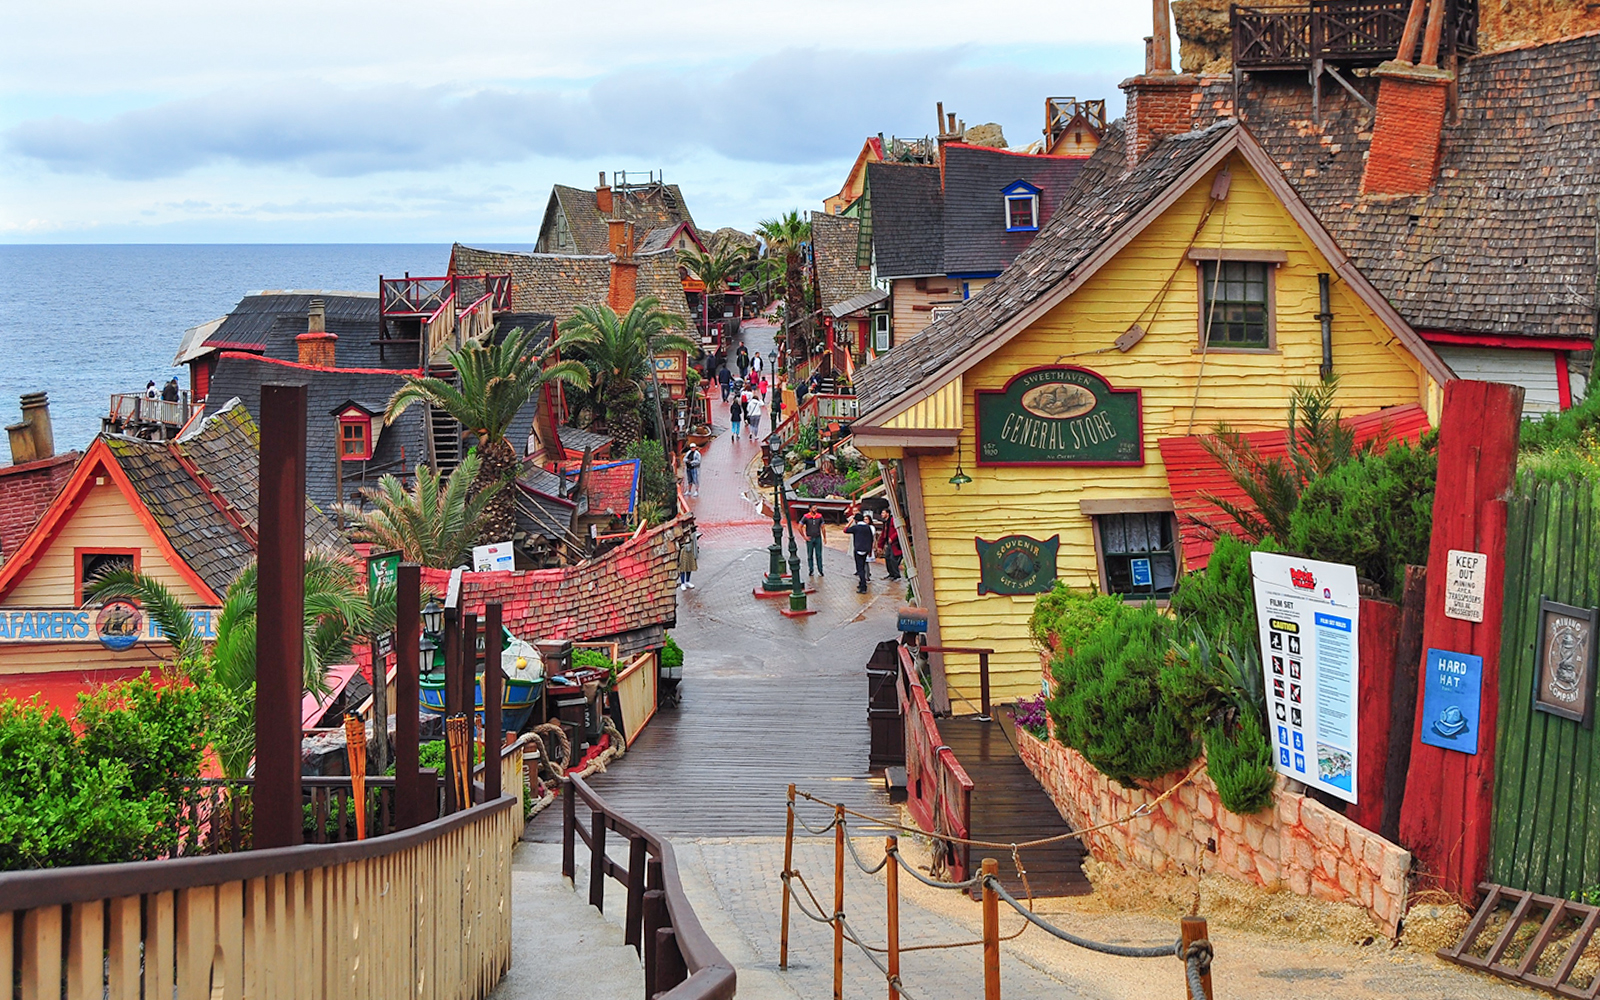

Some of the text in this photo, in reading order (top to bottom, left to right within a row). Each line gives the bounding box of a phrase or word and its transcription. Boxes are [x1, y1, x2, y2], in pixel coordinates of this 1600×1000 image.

[1023, 371, 1092, 387] SWEETHAVEN
[1001, 410, 1118, 450] GENERAL STORE
[996, 540, 1040, 559] SOUVENIR
[1455, 555, 1478, 569] KEEP
[1000, 574, 1037, 589] GIFT SHOP
[1459, 569, 1474, 580] OUT
[1453, 580, 1476, 589] MINING
[1269, 598, 1294, 609] FILM SET
[1272, 620, 1297, 632] CAUTION
[1555, 617, 1582, 631] MINING
[1438, 658, 1467, 675] HARD
[1440, 674, 1460, 687] HAT
[1548, 682, 1580, 702] COMPANY
